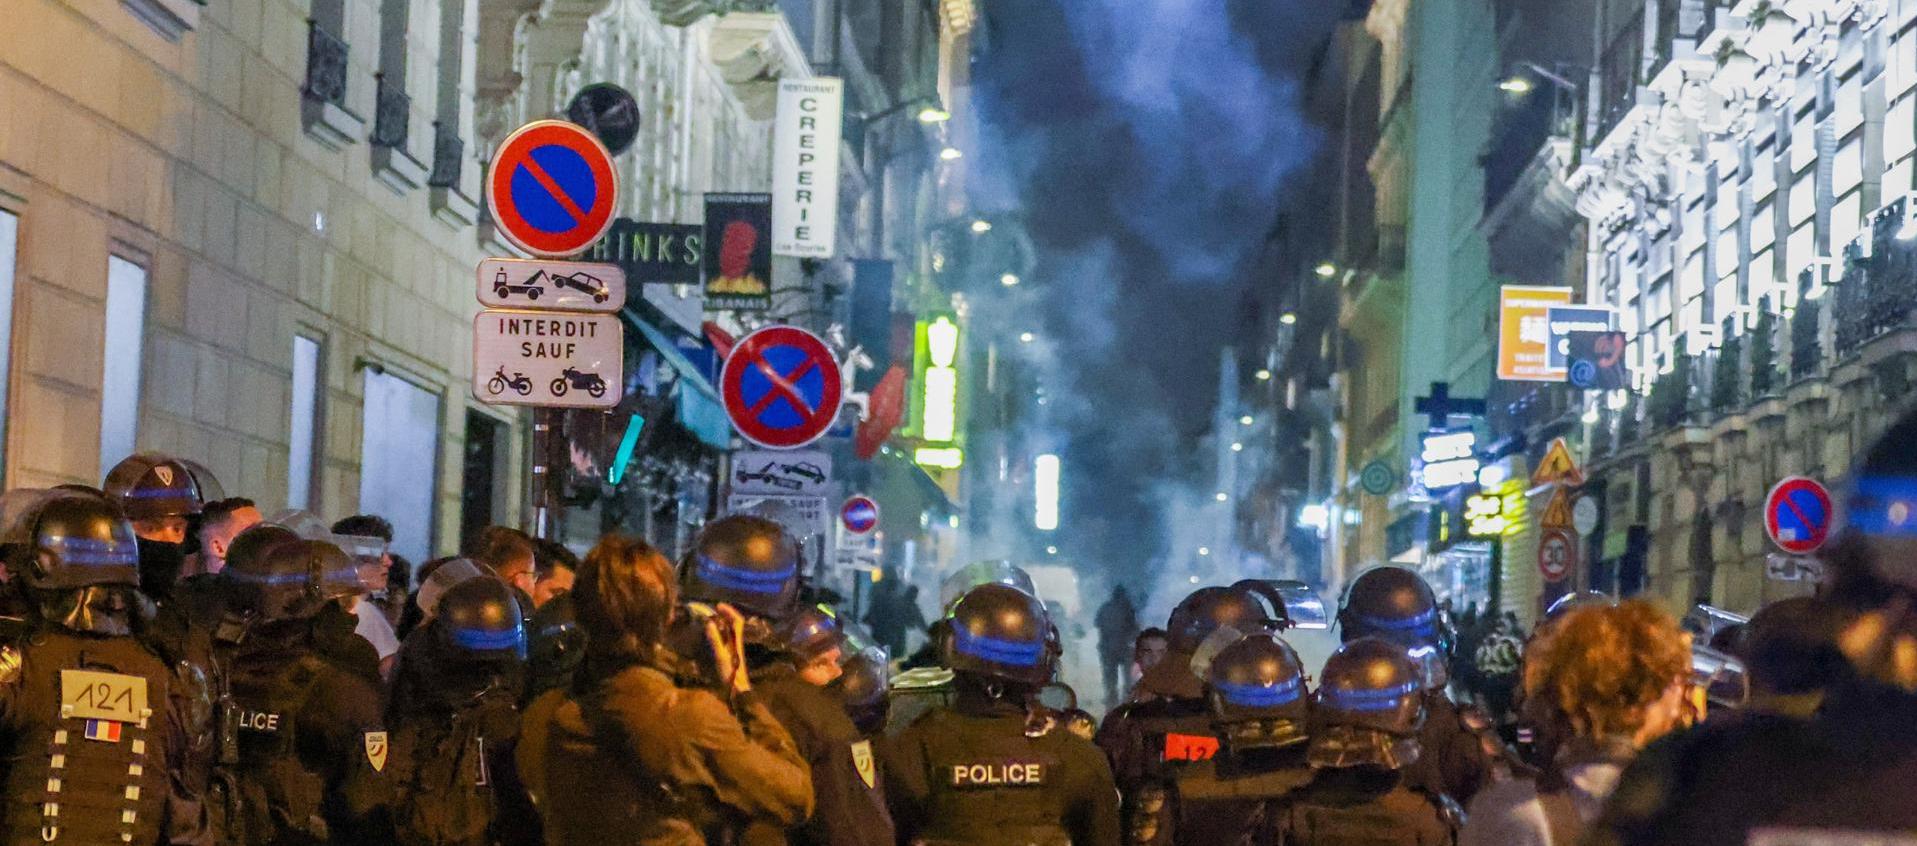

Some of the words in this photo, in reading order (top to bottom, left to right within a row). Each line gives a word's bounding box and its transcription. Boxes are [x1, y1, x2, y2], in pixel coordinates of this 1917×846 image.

[795, 97, 817, 240] CREPERIE
[593, 230, 699, 265] RINKS
[499, 318, 598, 338] INTERDIT
[521, 342, 576, 359] SAUF
[75, 683, 132, 713] 121
[239, 711, 279, 730] LICE
[953, 763, 1041, 784] POLICE
